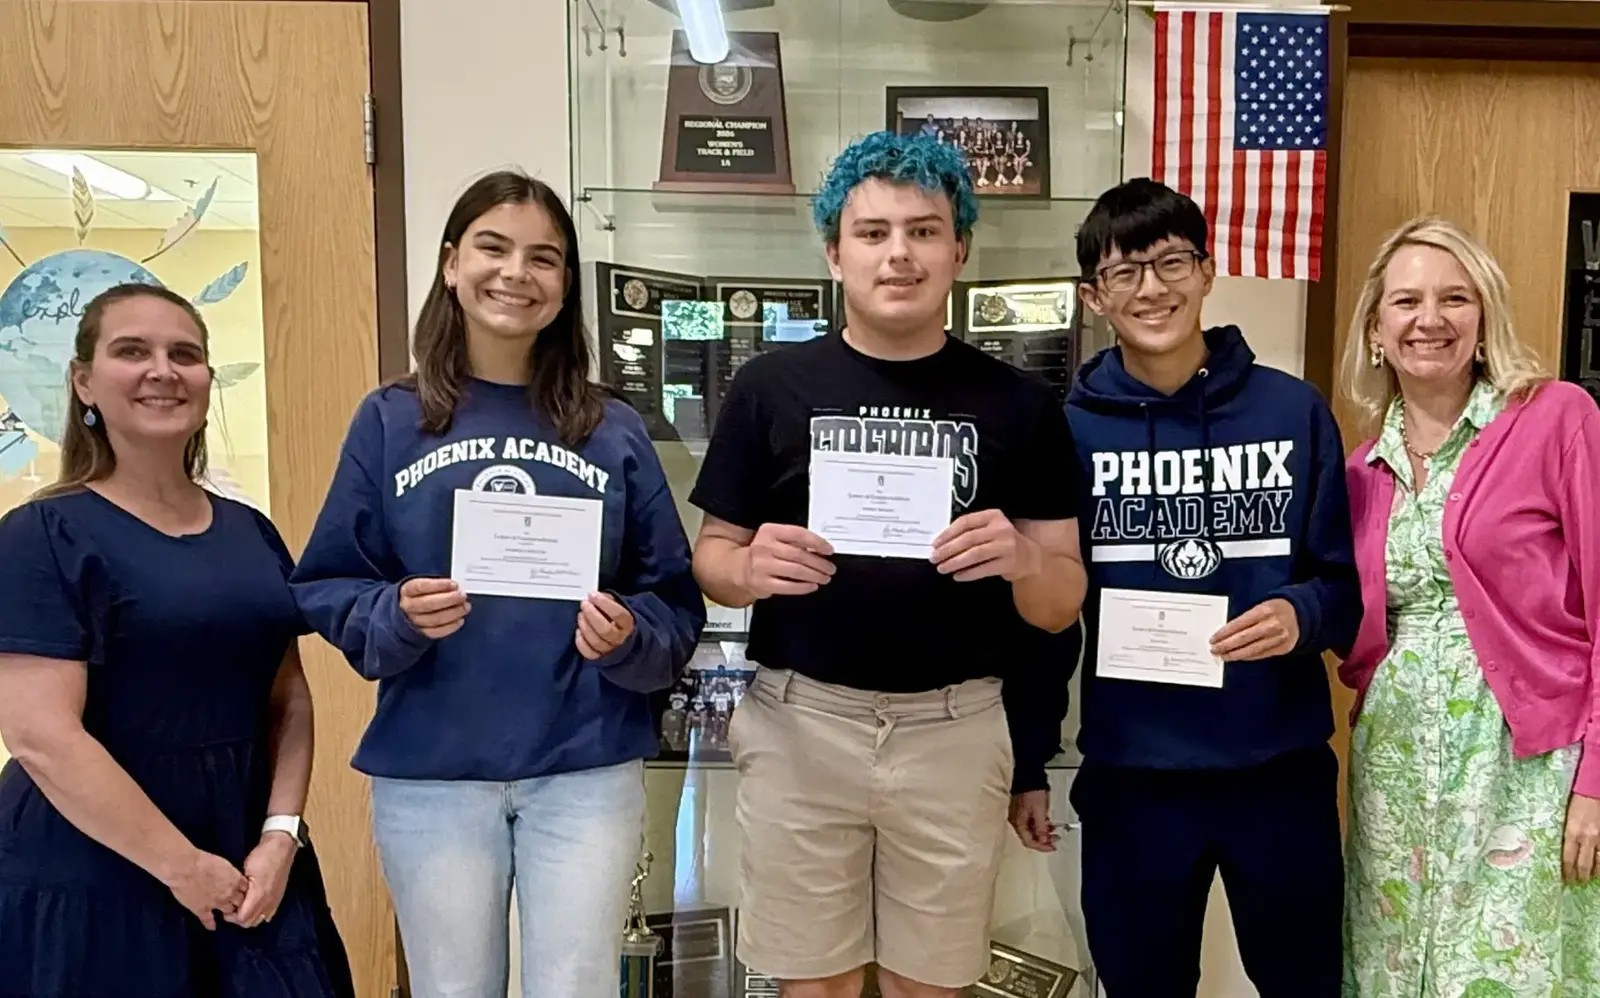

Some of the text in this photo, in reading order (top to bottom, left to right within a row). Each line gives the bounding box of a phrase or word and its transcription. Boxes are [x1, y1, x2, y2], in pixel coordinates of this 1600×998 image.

[684, 120, 767, 130] REGIONAL CHAMPION
[707, 140, 743, 148] WOMEN'S
[696, 148, 722, 156] TRACK
[724, 148, 731, 156] &
[859, 406, 931, 419] PHOENIX
[395, 437, 496, 497] PHOENIX
[502, 437, 610, 494] ACADEMY
[1092, 440, 1293, 497] PHOENIX
[1091, 490, 1293, 540] ACADEMY
